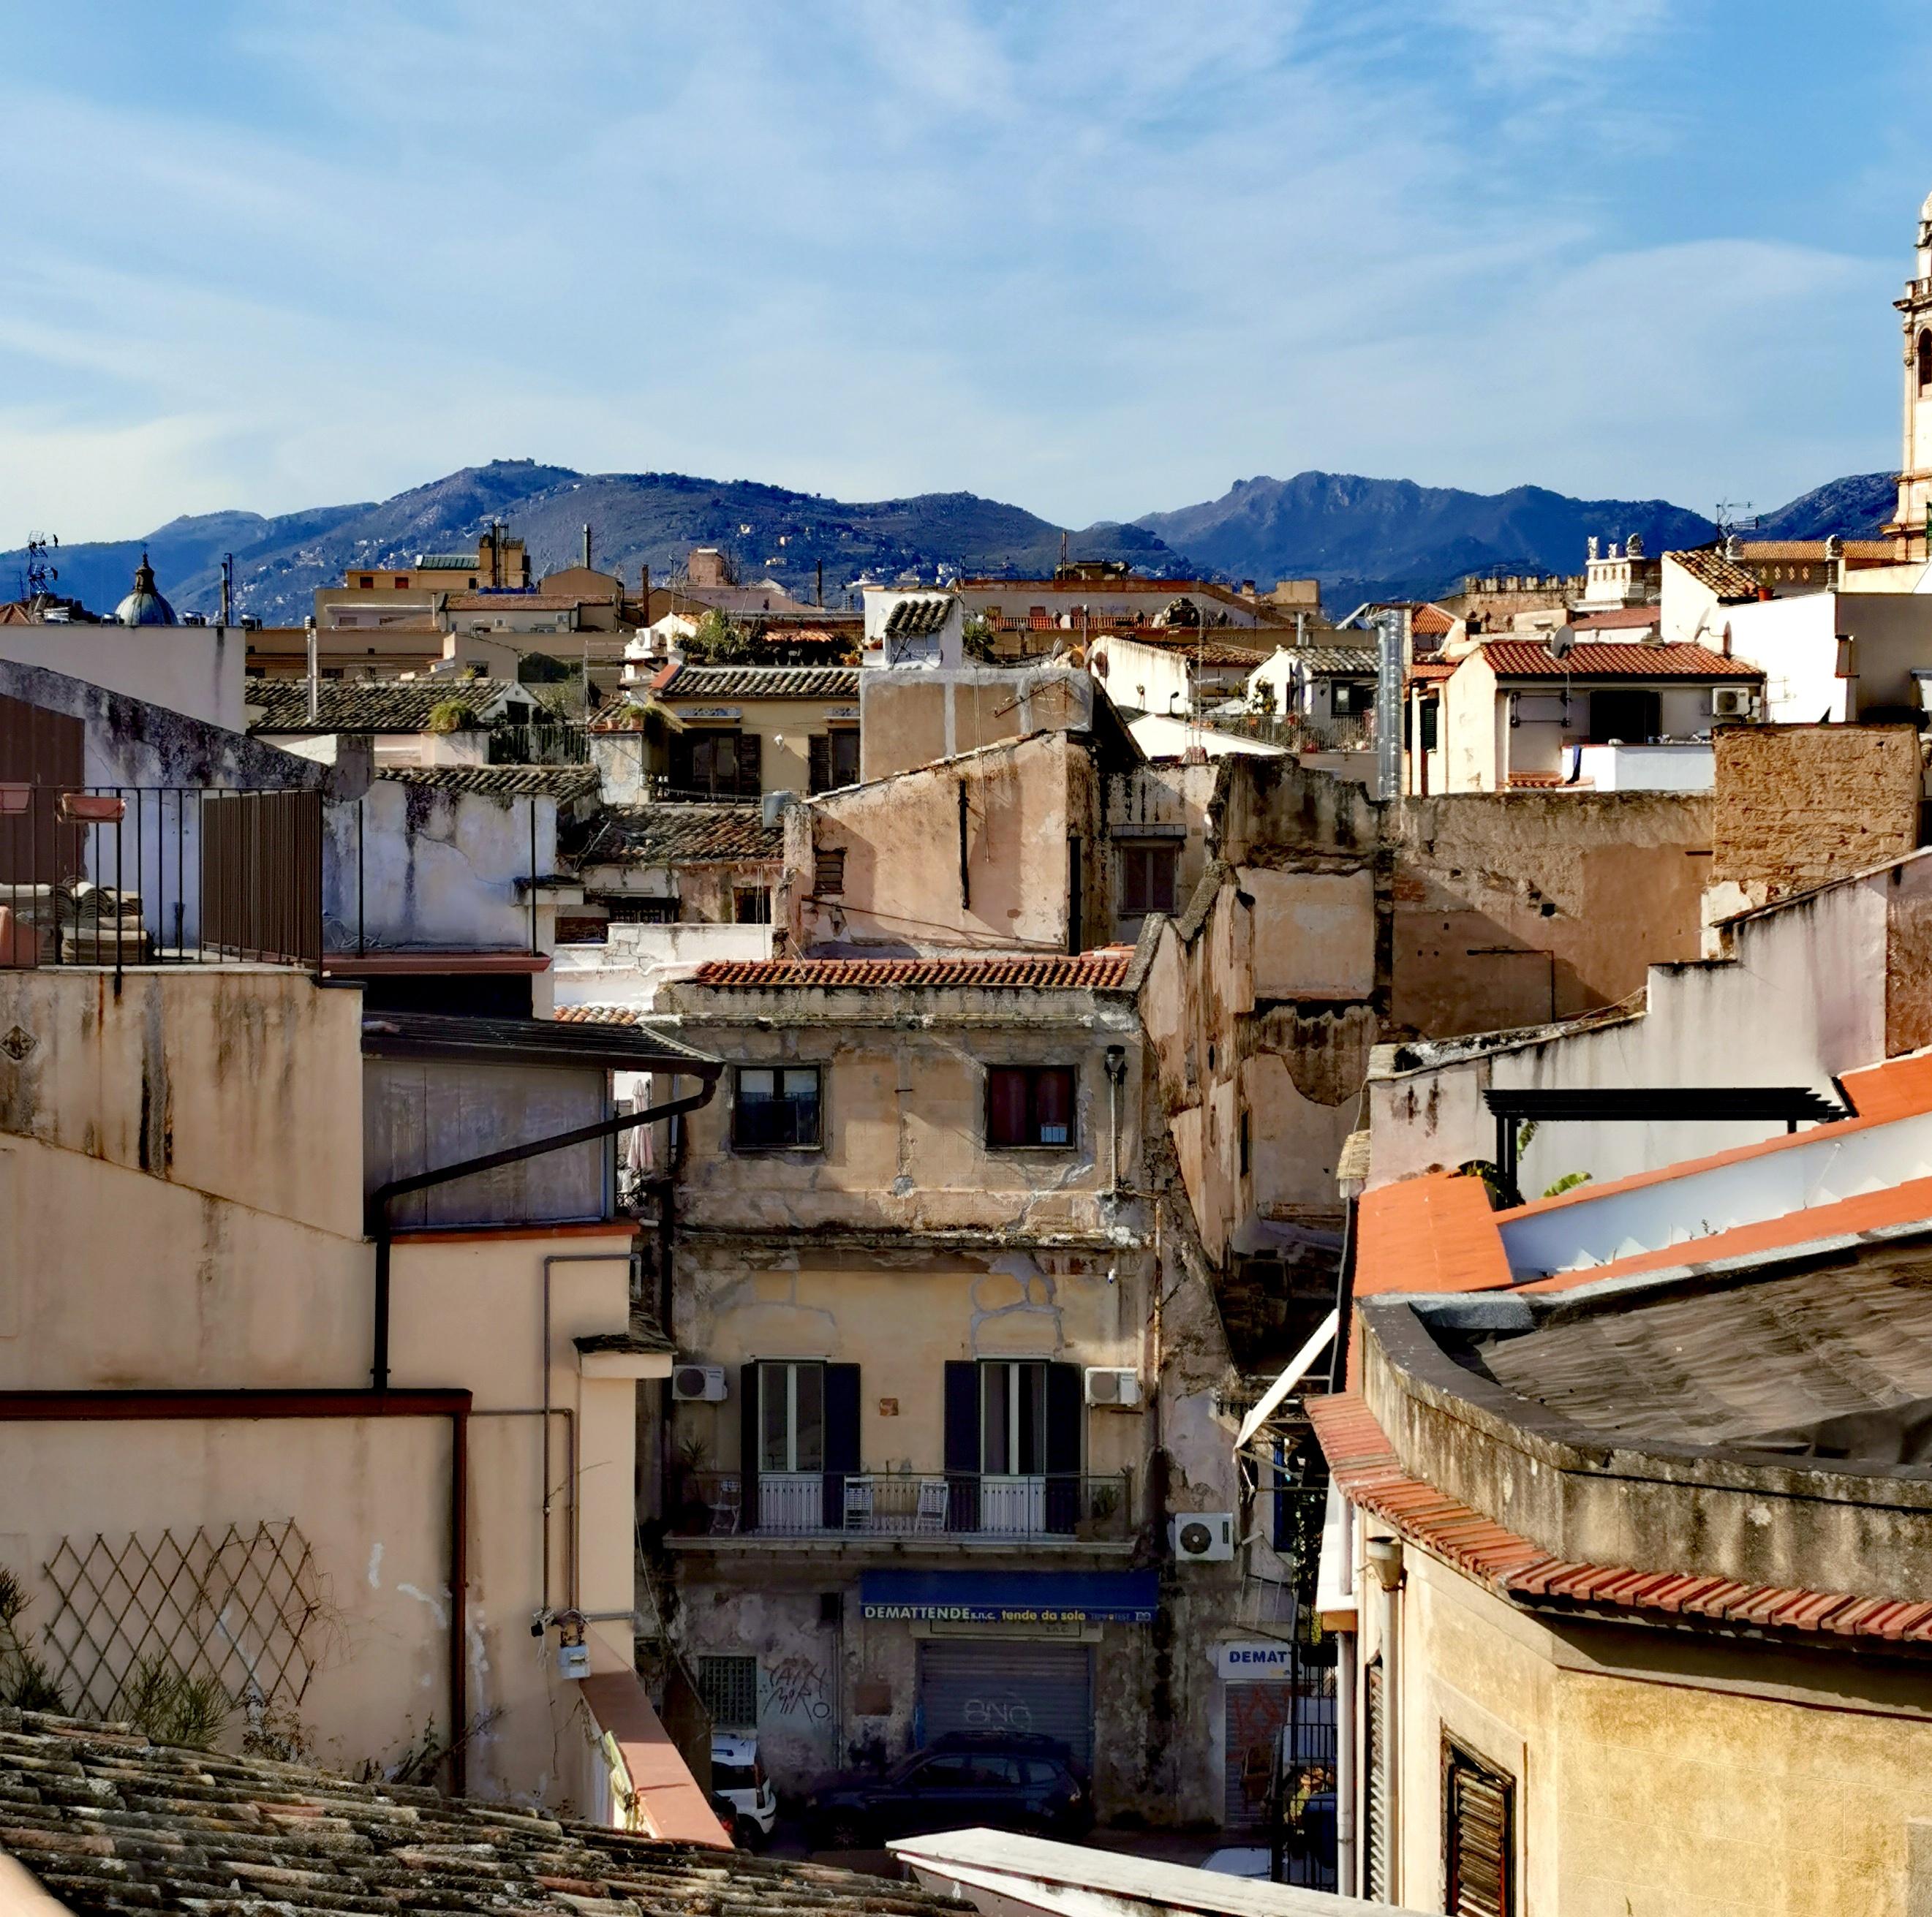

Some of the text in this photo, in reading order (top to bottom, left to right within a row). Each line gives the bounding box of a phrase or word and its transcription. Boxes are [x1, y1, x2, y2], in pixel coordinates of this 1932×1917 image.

[864, 1607, 970, 1619] DEMATTENDE
[1001, 1610, 1037, 1621] tende
[1041, 1610, 1057, 1621] da
[1061, 1610, 1086, 1621] sole
